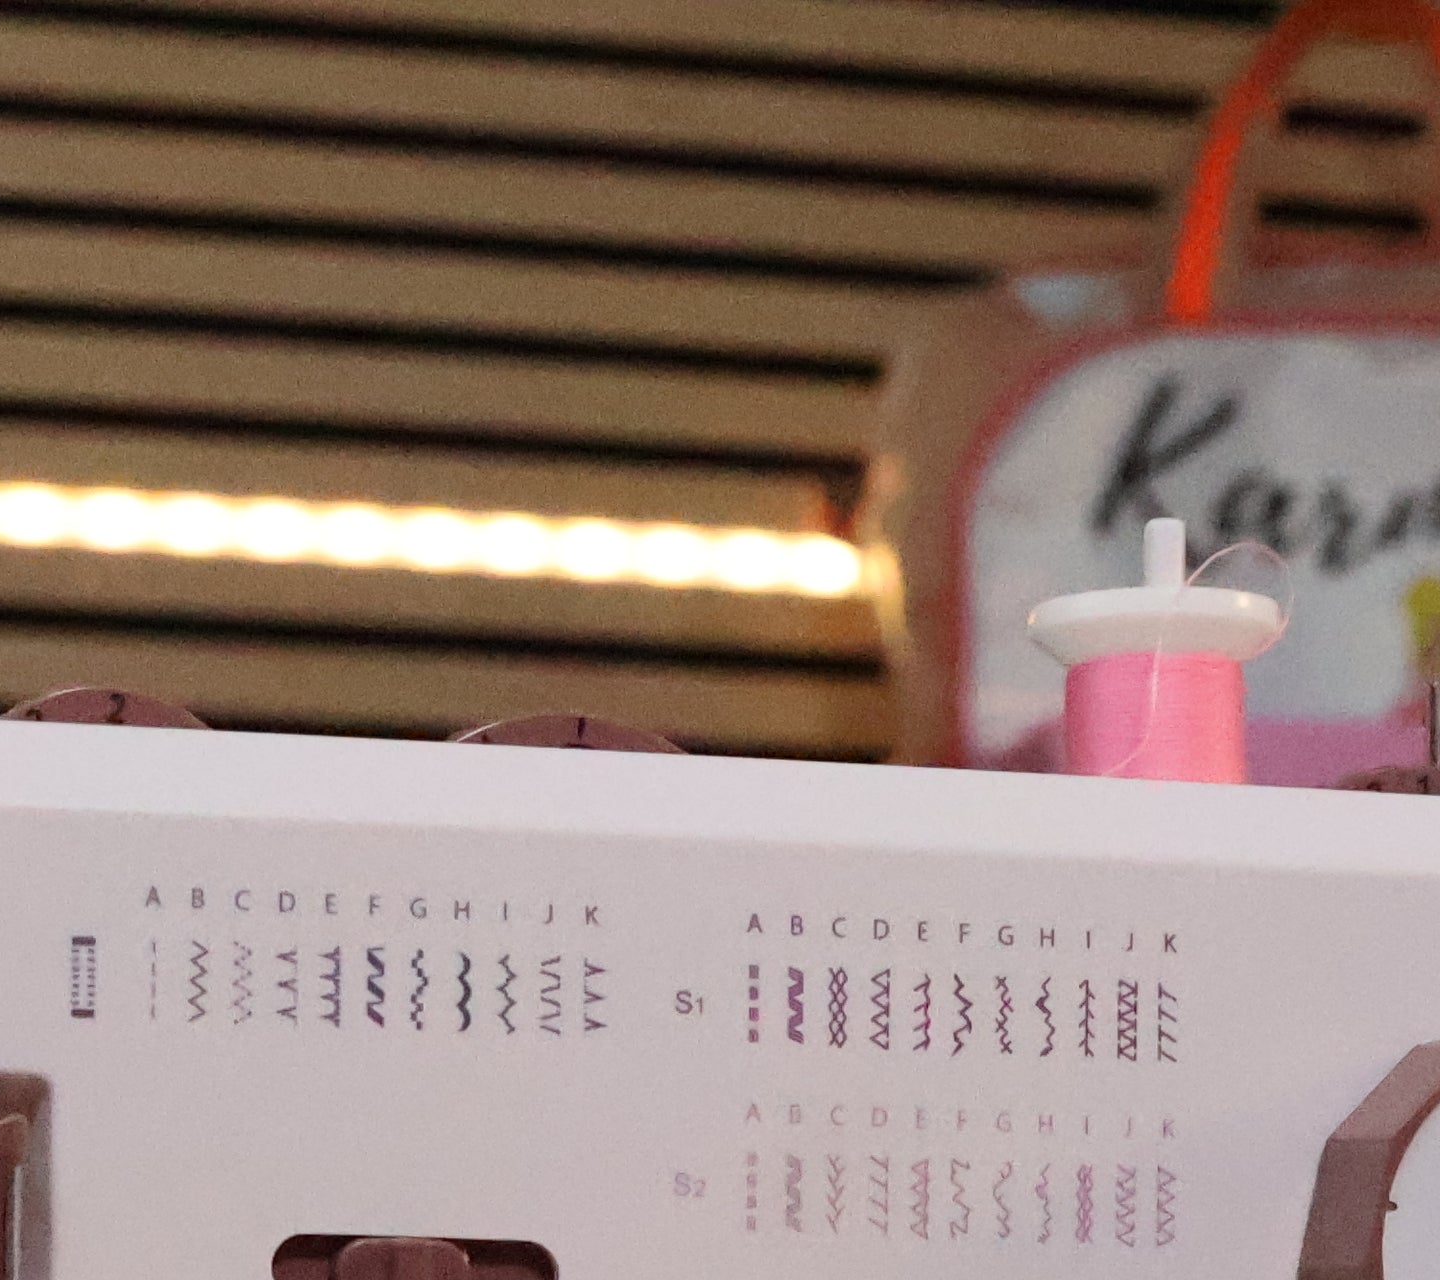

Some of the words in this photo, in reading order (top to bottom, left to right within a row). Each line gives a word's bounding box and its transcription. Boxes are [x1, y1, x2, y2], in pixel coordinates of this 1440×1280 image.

[145, 885, 162, 907] A
[190, 887, 206, 910] B
[234, 889, 250, 912] C
[278, 890, 296, 913] D
[324, 893, 337, 915] E
[368, 894, 380, 916] F
[409, 897, 428, 919] G
[453, 900, 471, 920] H
[502, 901, 508, 922] I
[544, 903, 554, 925] J
[584, 905, 599, 925] K
[746, 913, 763, 934] A
[790, 914, 804, 937] B
[831, 916, 846, 939] C
[873, 918, 890, 941] D
[917, 920, 928, 942] E
[958, 922, 970, 944] F
[997, 925, 1015, 947] G
[1039, 927, 1055, 948] H
[1085, 930, 1091, 950] I
[1125, 932, 1134, 952] J
[1164, 933, 1177, 953] K
[675, 989, 704, 1015] S1
[745, 1102, 762, 1123] A
[788, 1103, 803, 1125] B
[829, 1104, 844, 1127] C
[870, 1106, 889, 1128] D
[915, 1107, 926, 1131] E
[956, 1109, 968, 1131] F
[994, 1110, 1012, 1133] G
[1038, 1114, 1054, 1133] H
[1083, 1116, 1090, 1136] I
[1124, 1116, 1133, 1139] J
[1162, 1119, 1175, 1139] K
[673, 1171, 707, 1198] S2
